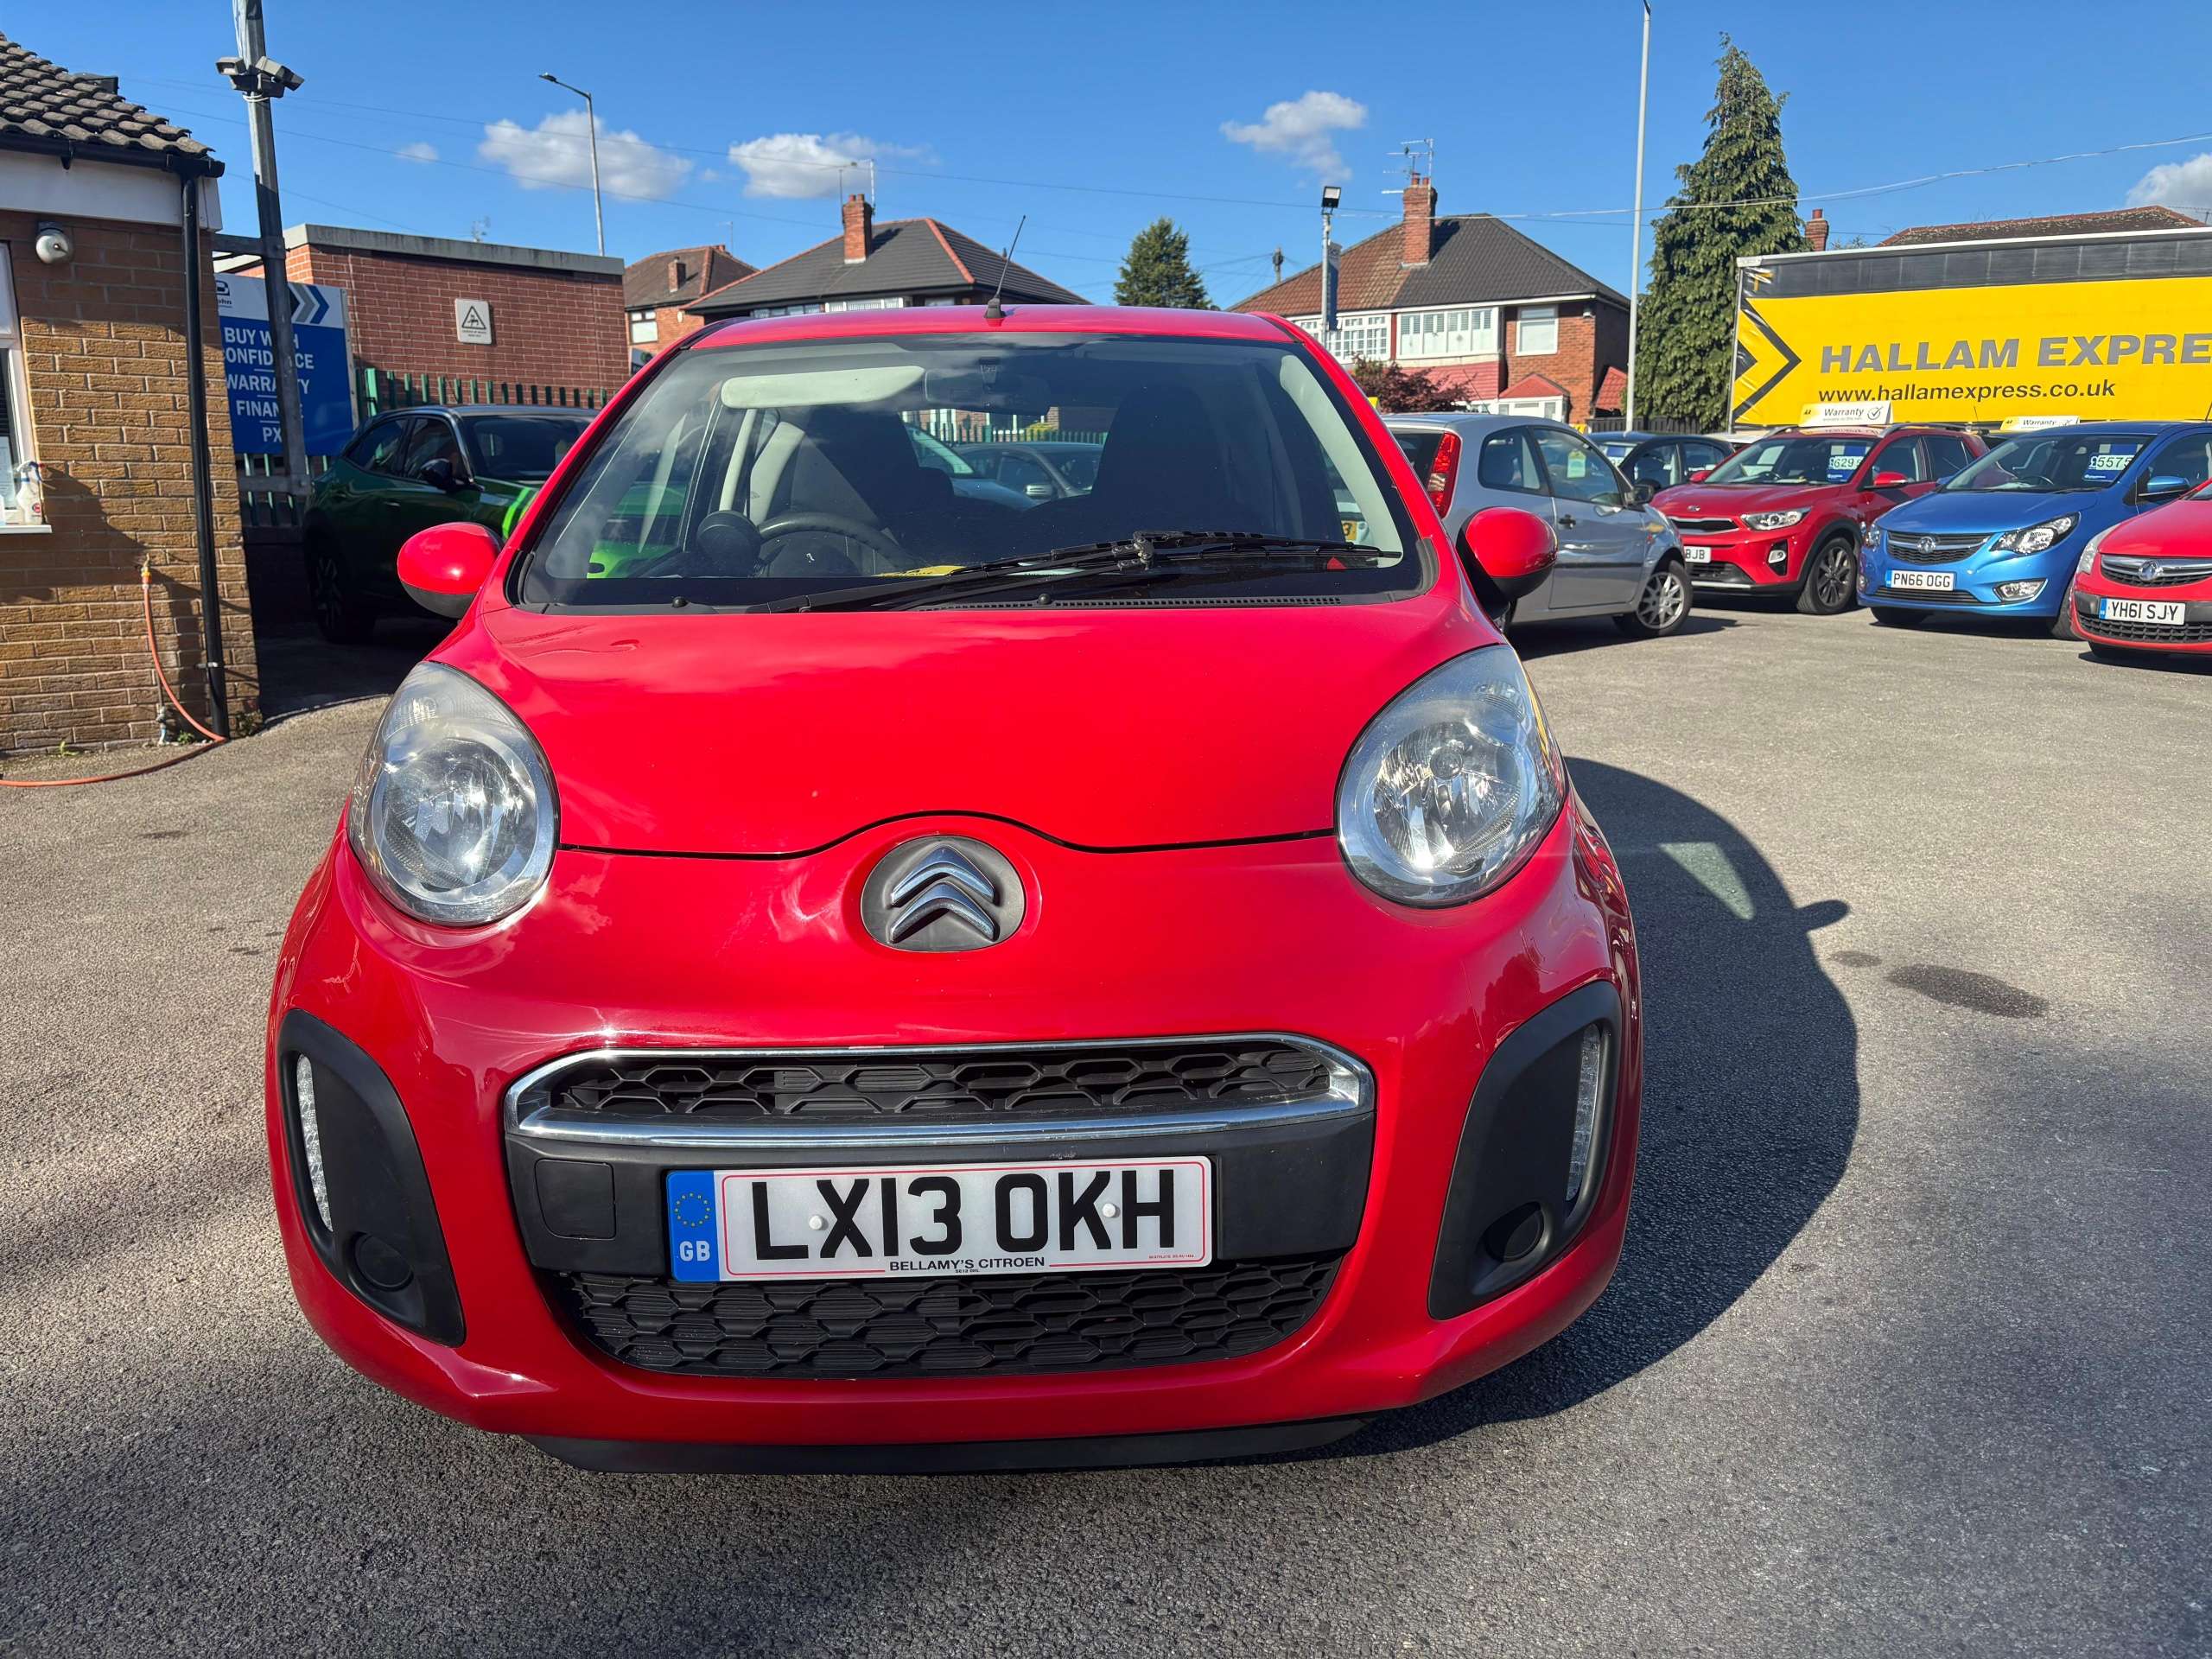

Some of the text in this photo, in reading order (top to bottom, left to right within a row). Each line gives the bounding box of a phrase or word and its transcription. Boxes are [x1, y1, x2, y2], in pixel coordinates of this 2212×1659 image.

[224, 327, 256, 345] BUY
[224, 347, 315, 369] ONFIDCE
[1821, 333, 2212, 373] HALLAM EXPRE
[227, 374, 309, 394] WARRY
[1818, 378, 2115, 403] www.hallamexpress.co.uk
[236, 400, 303, 418] FINAN
[1824, 408, 1864, 416] Warranty
[263, 427, 282, 442] PX
[1893, 573, 1950, 588] PN66 OGG
[2112, 601, 2178, 620] YH61 SJY
[752, 1169, 1174, 1260] LX13 OKH
[679, 1240, 710, 1262] GB
[889, 1257, 1045, 1271] BELLAMY'S CITROEN
